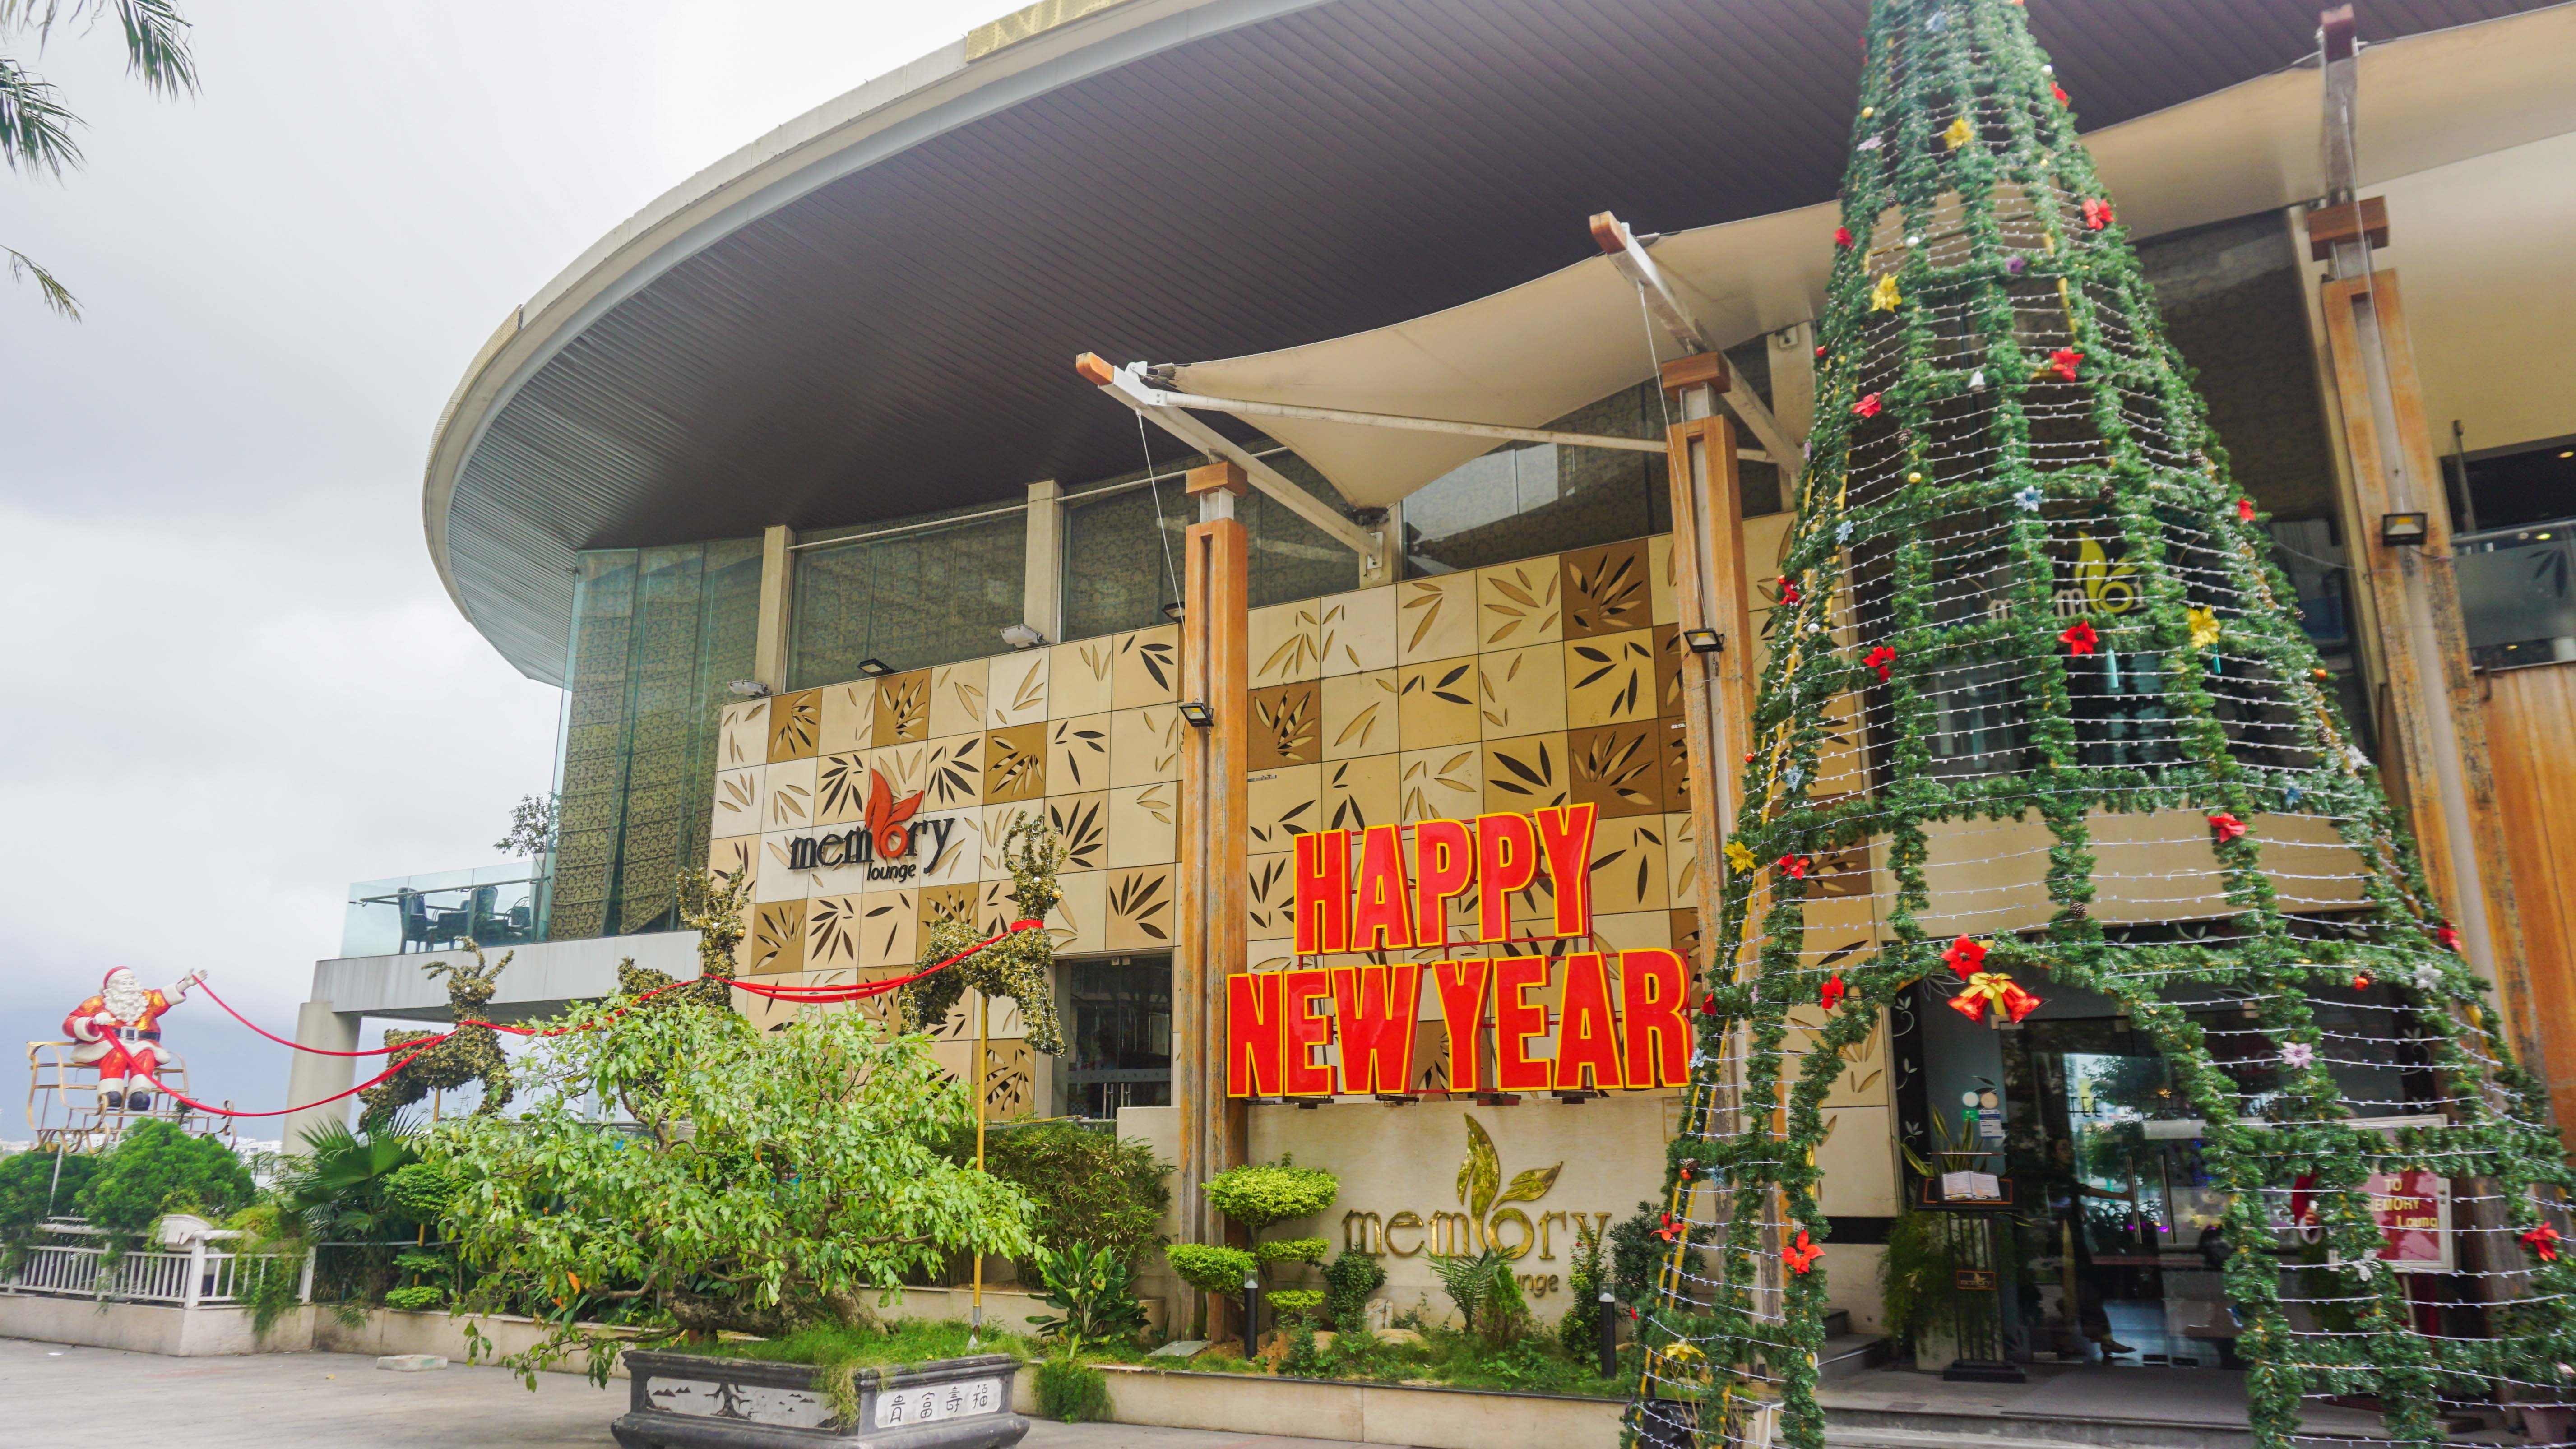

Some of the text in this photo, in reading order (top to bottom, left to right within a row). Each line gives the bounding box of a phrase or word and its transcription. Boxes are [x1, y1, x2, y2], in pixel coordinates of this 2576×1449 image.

[788, 817, 956, 875] memory
[866, 862, 917, 883] lounge
[1294, 802, 1599, 955] HAPPY
[1227, 948, 1693, 1097] NEW YEAR
[2384, 1178, 2403, 1191] TO
